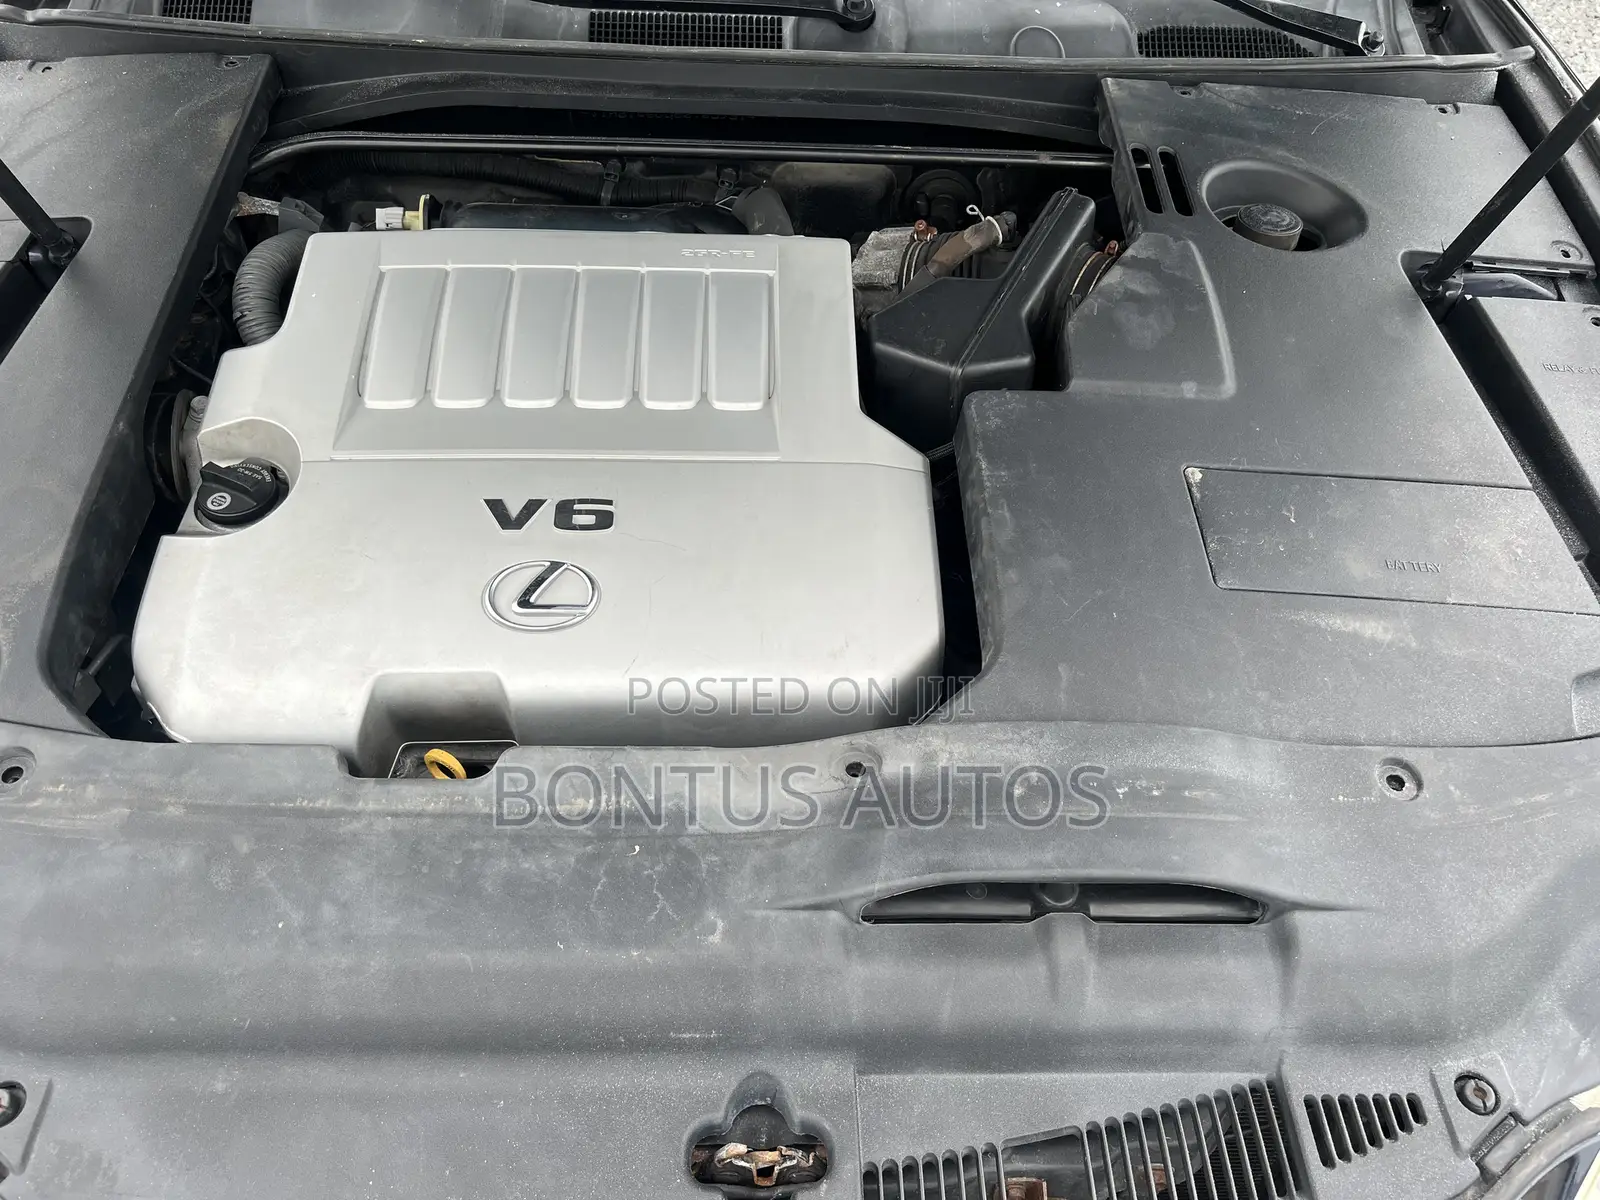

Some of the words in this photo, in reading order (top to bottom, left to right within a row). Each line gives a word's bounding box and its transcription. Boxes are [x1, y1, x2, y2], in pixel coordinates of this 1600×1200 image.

[1542, 363, 1574, 373] RELAY
[481, 498, 616, 534] V6
[1384, 559, 1441, 573] BATTERY
